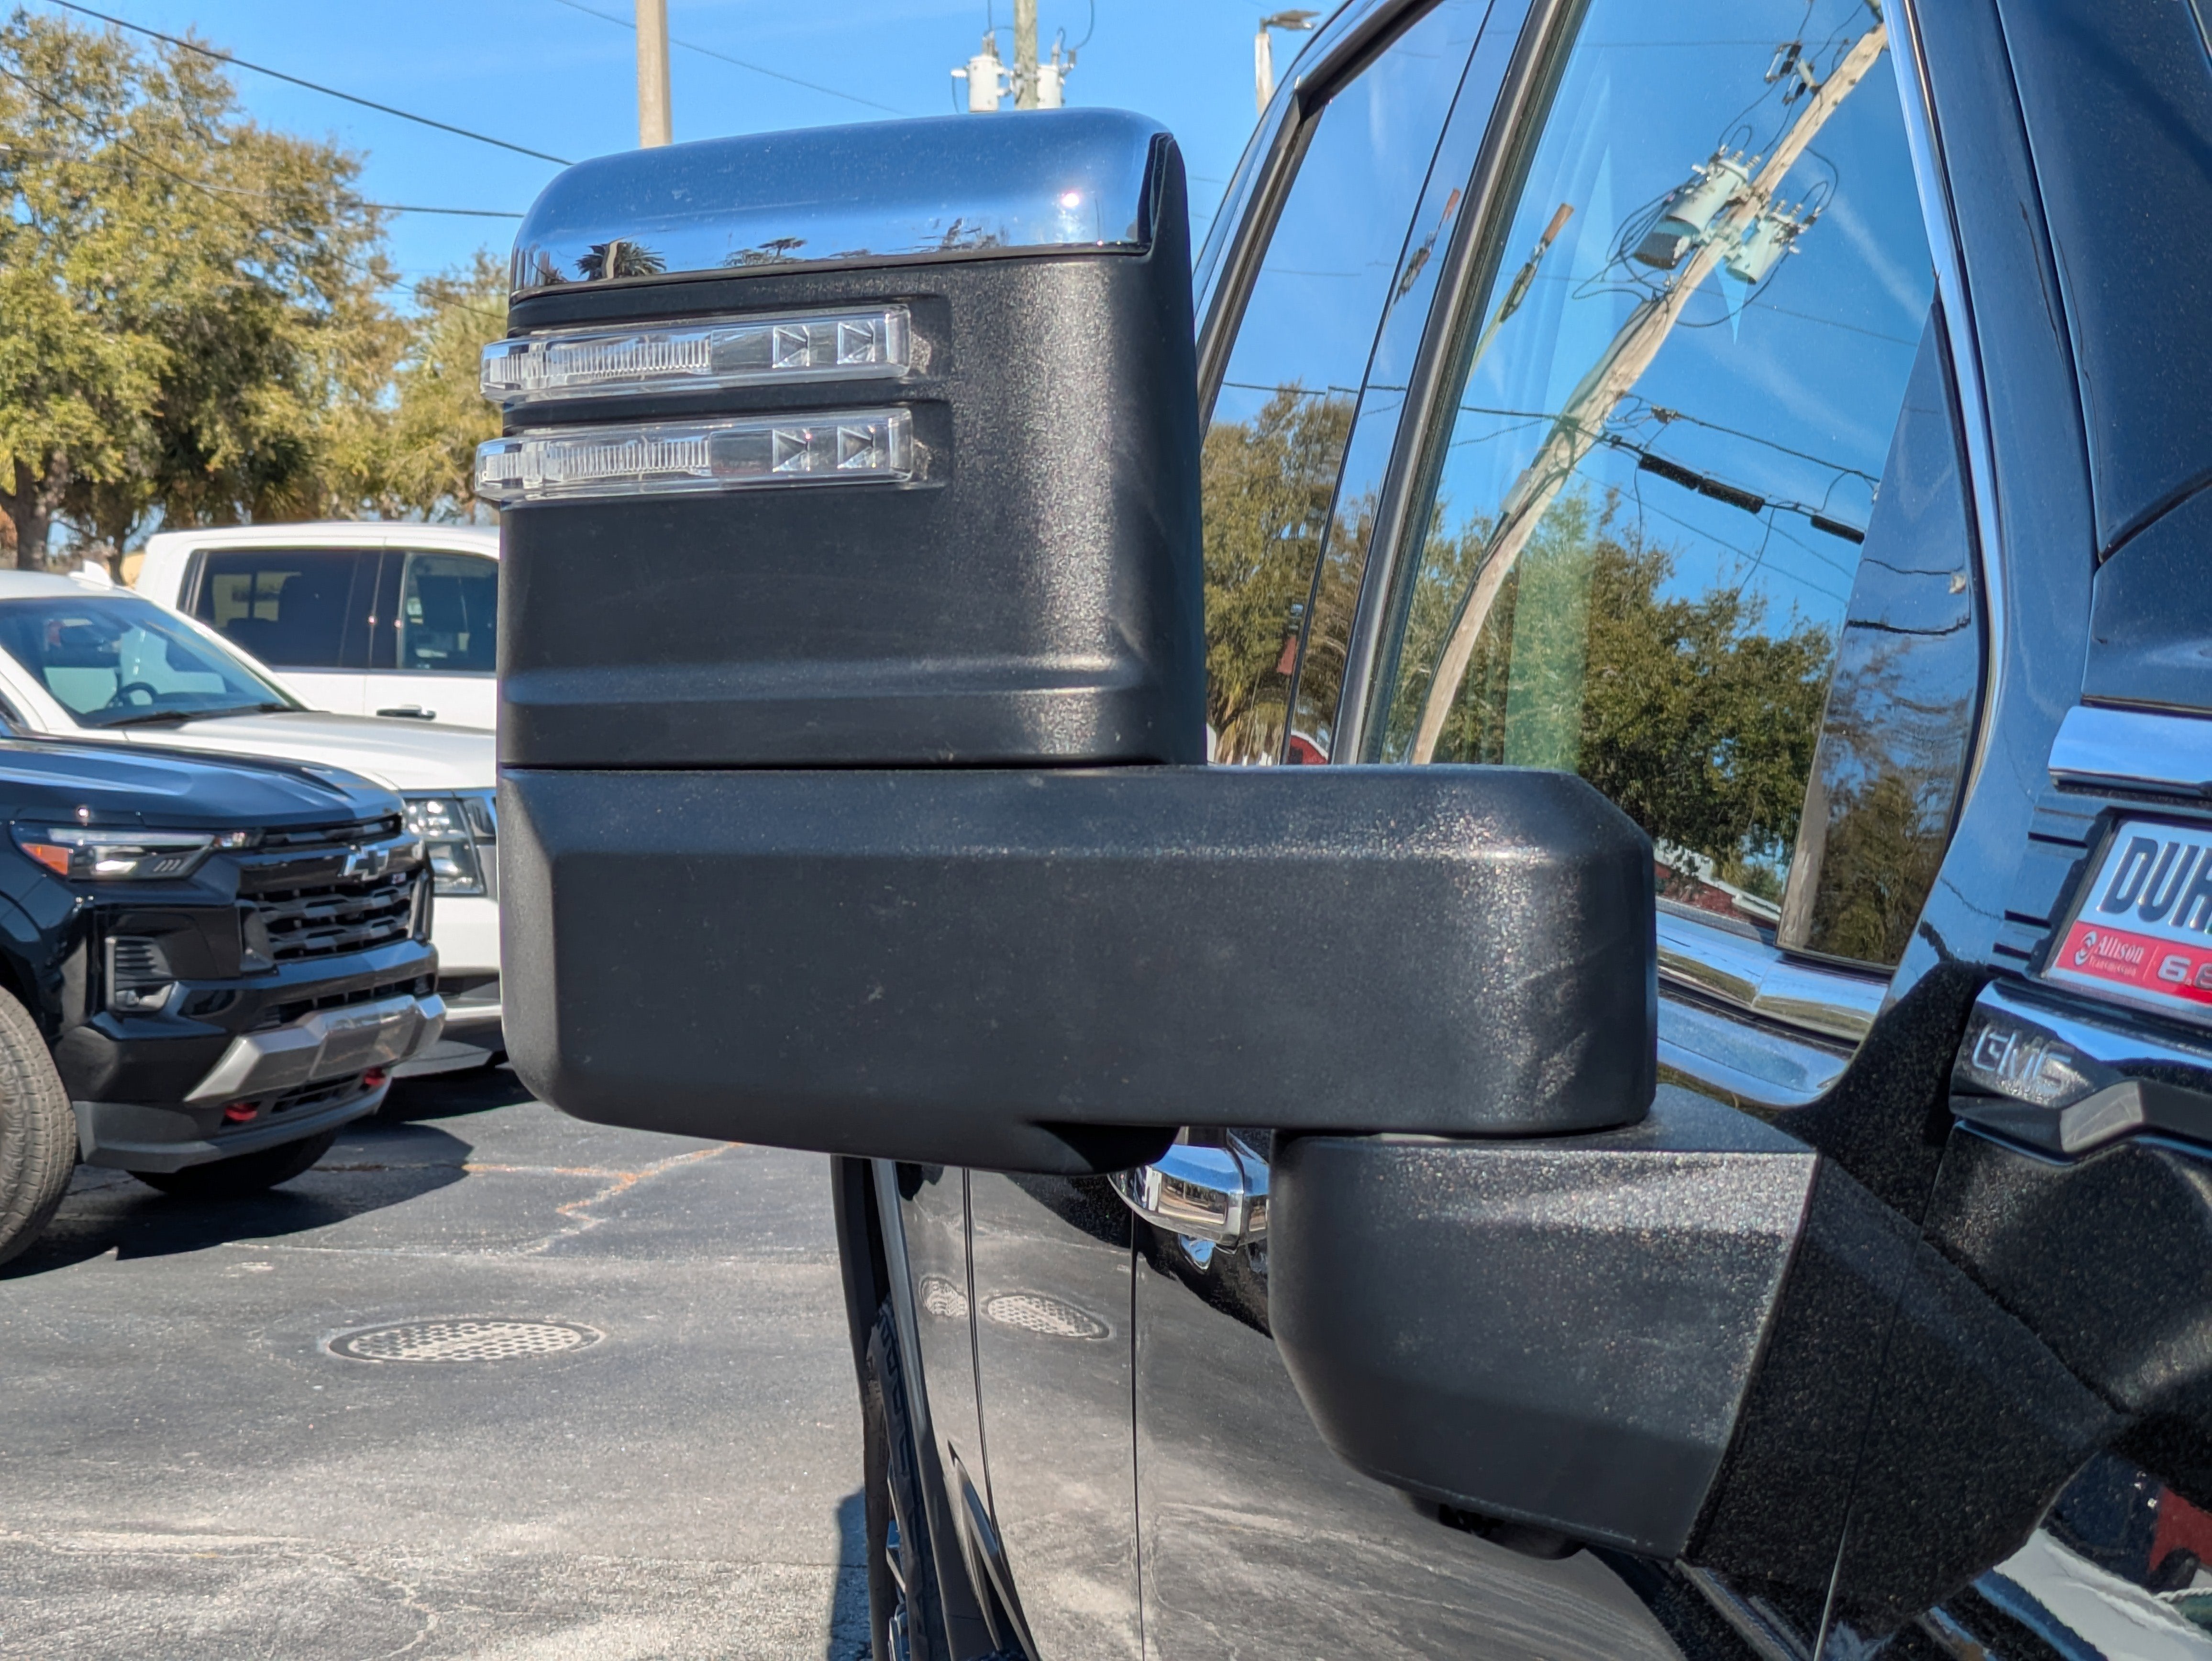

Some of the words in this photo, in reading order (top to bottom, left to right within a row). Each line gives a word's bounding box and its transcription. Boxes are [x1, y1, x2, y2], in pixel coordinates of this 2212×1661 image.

[2096, 836, 2212, 933] DUR
[2094, 935, 2144, 964] Allison
[1972, 1025, 2073, 1094] GMC
